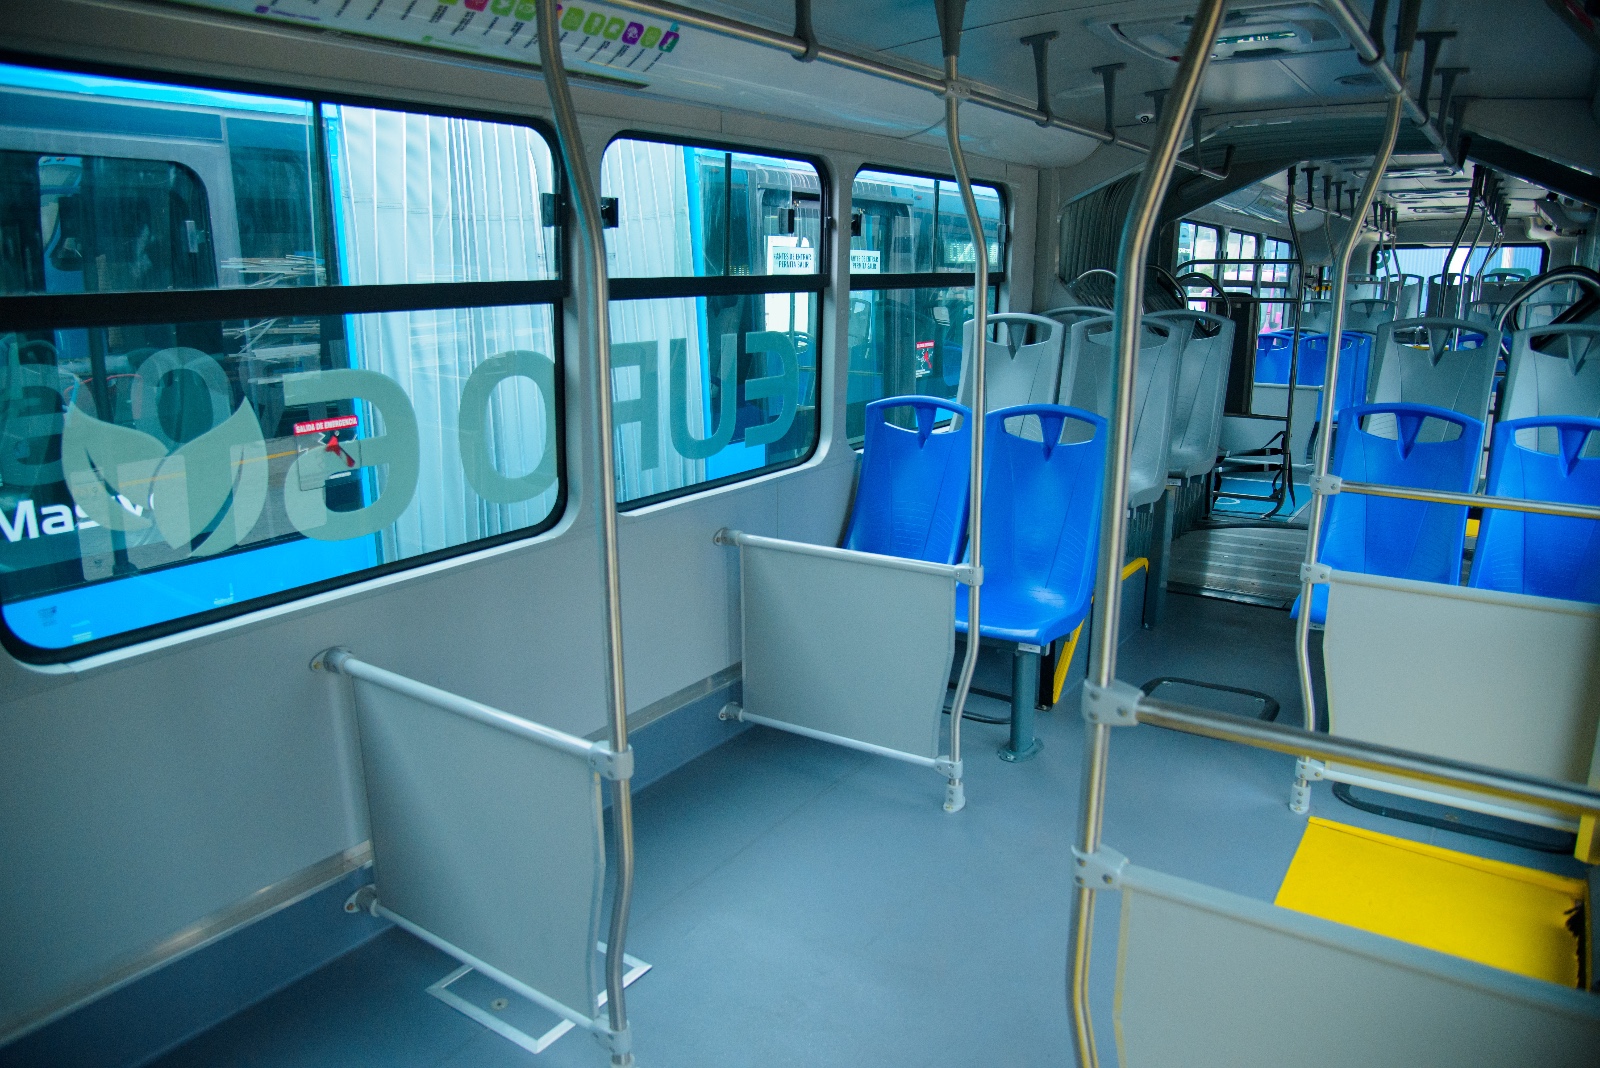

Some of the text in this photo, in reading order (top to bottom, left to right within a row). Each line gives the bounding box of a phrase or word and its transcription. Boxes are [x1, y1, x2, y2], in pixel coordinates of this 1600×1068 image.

[295, 417, 358, 434] SALIDA DE EMERGENCIA
